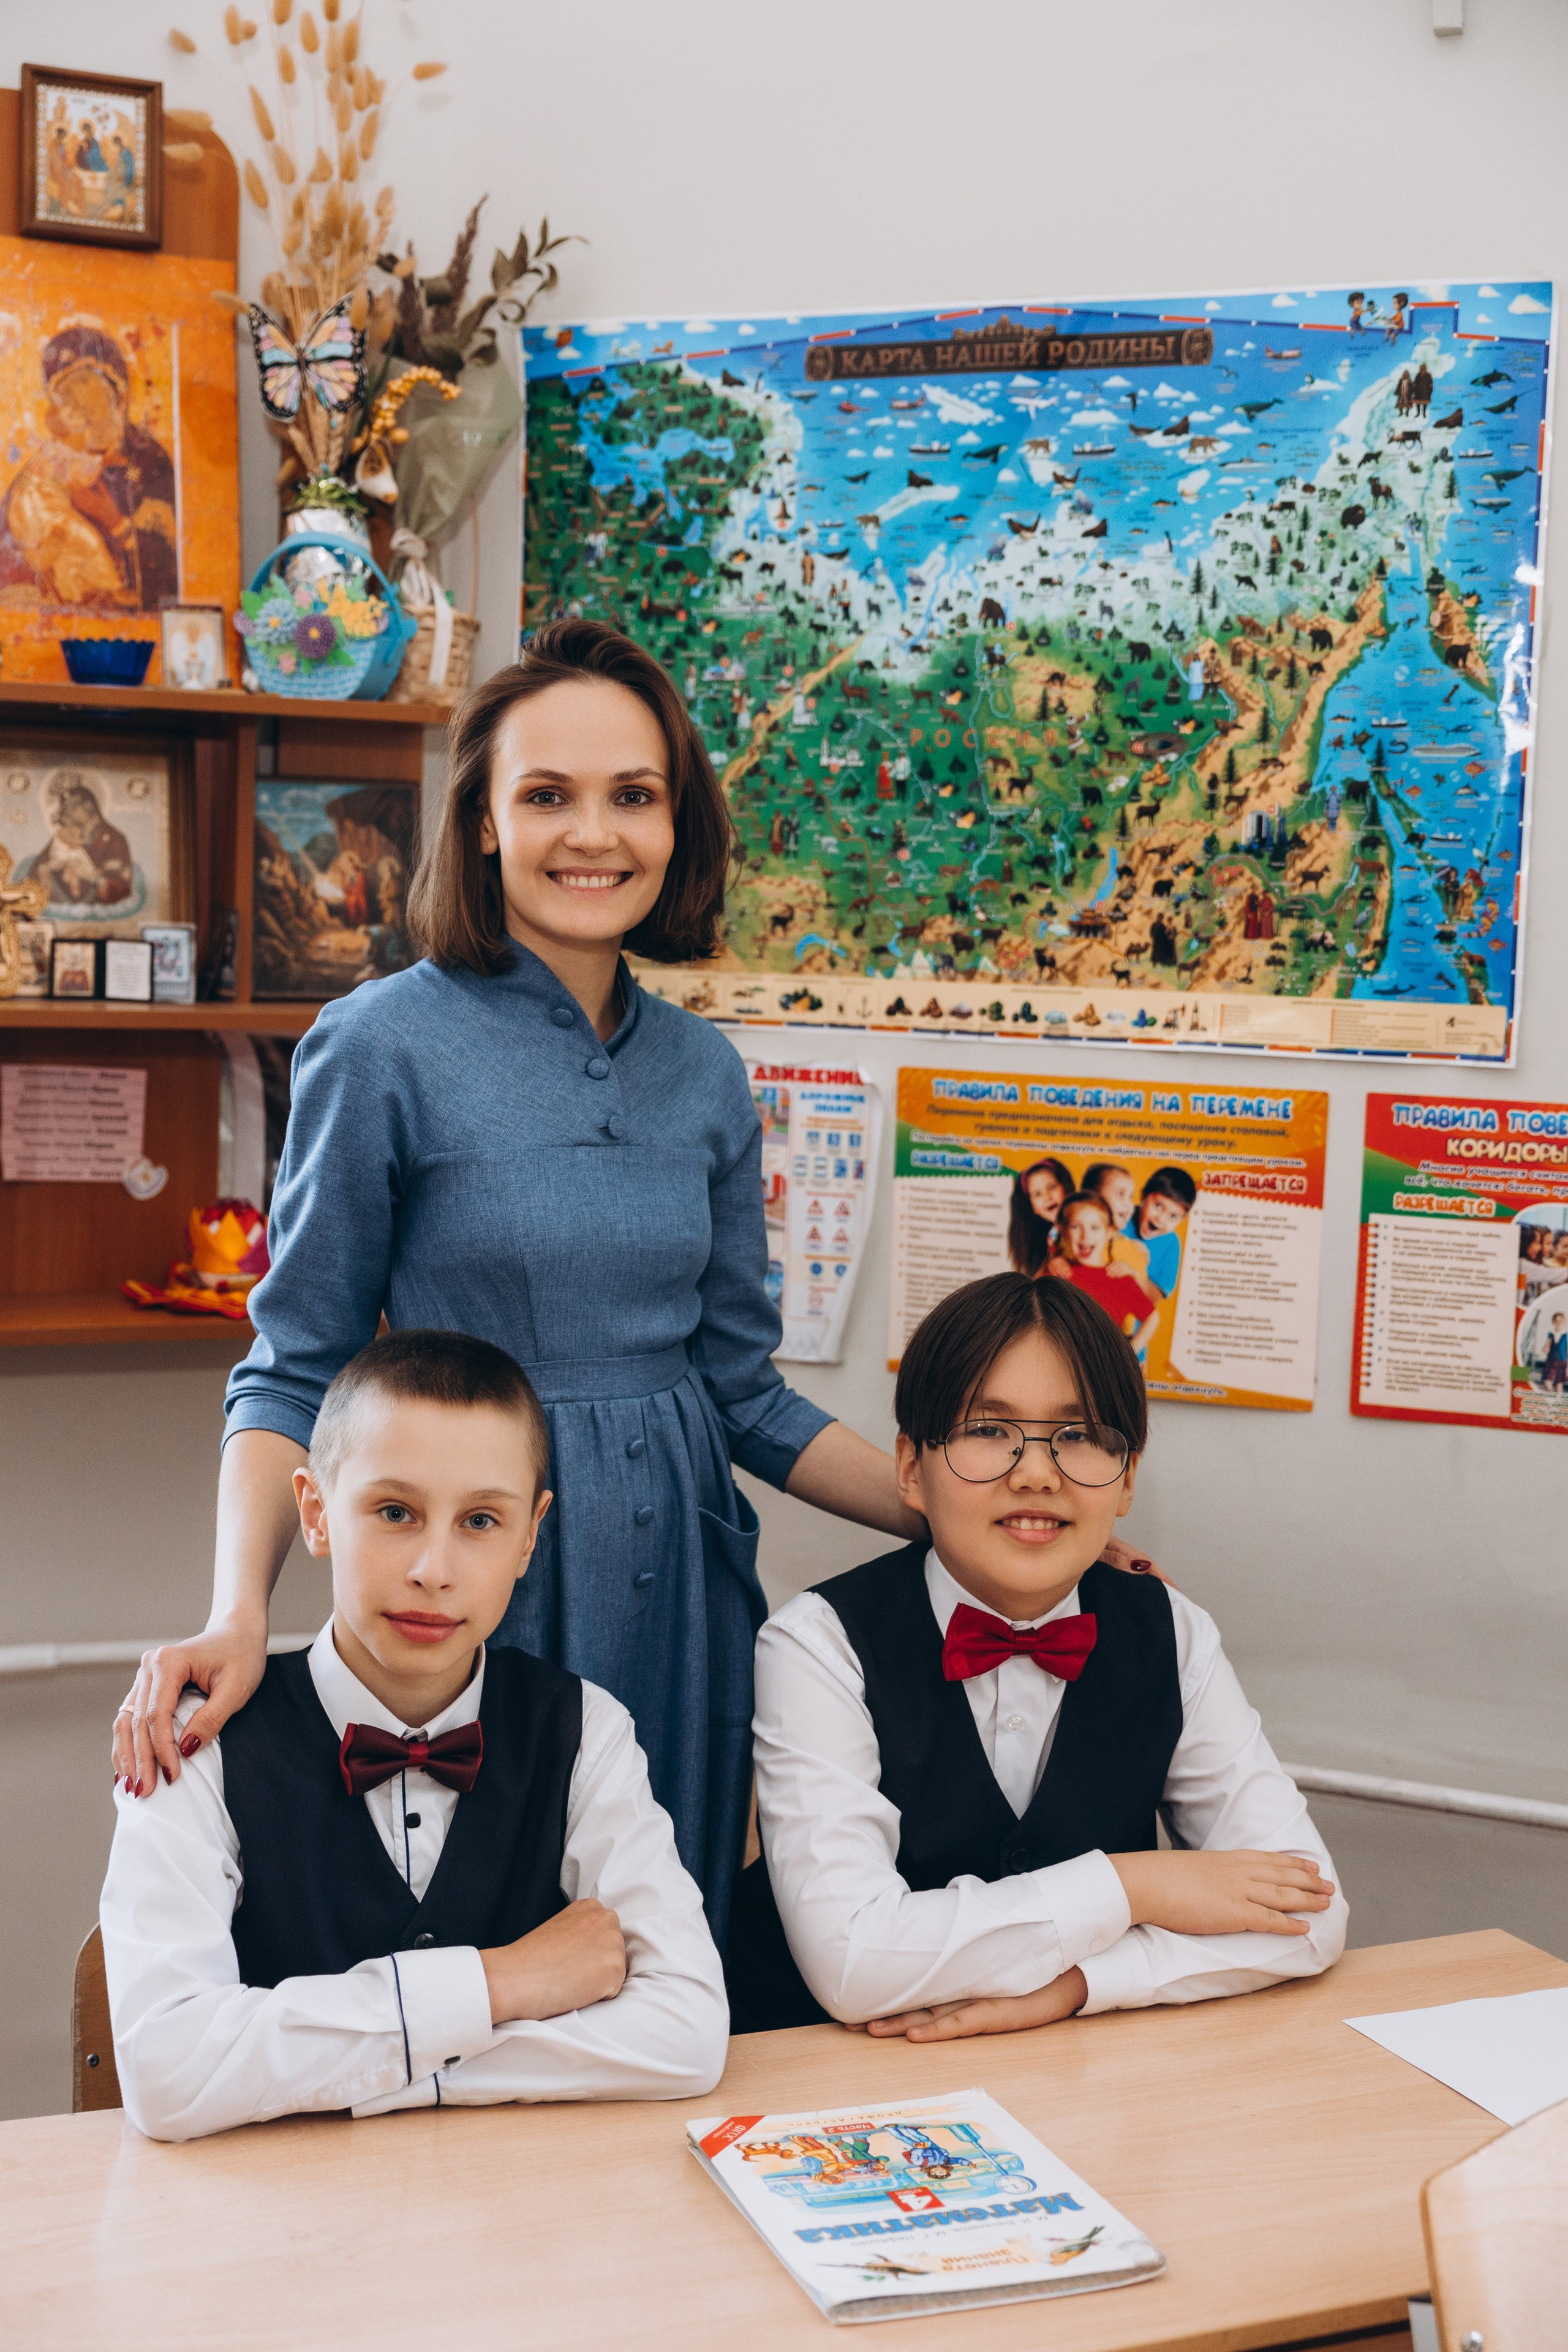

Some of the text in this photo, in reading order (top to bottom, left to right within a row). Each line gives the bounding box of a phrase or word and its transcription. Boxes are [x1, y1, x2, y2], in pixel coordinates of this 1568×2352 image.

[840, 334, 1175, 373] КАРТА НАШЕЙ РОДИНЫ
[910, 728, 1058, 748] РОССИЯ
[932, 1078, 1294, 1121] ПРАВИЛА ПОВЕДЕНИЯ НА ПЕРЕМЕНЕ
[1393, 1105, 1568, 1136] ПРАВИЛА ПОВЕ
[1446, 1137, 1568, 1164] КОРИДОРЫ
[1203, 1172, 1306, 1193] ЗАПРЕЩАЕТСЯ
[1393, 1193, 1495, 1217] РАЗРЕШАЕТСЯ
[787, 2111, 902, 2127] ДРОФА Астрель
[837, 2124, 871, 2133] Часть
[722, 2124, 747, 2141] ФГОС
[897, 2193, 933, 2211] 4
[793, 2192, 1085, 2244] Математика
[941, 2248, 1012, 2264] знаний
[941, 2255, 1030, 2272] Планета
